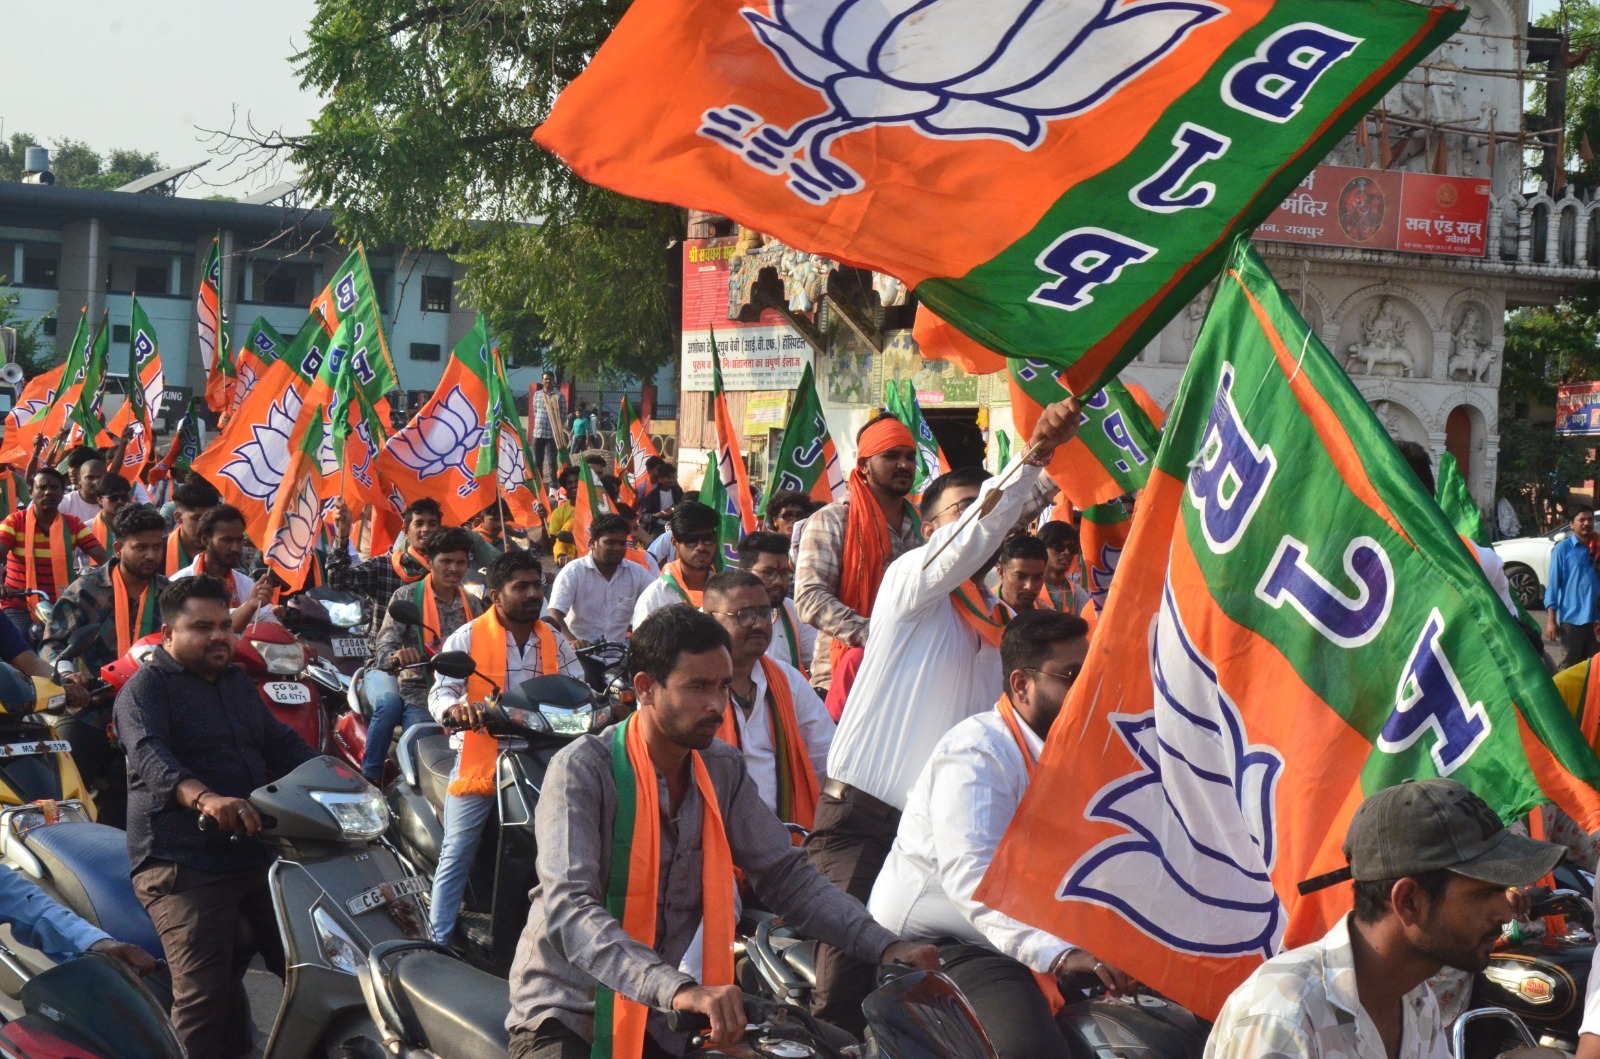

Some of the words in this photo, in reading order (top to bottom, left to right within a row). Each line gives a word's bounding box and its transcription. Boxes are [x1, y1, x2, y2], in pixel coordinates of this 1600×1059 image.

[1280, 193, 1328, 218] मंदिर
[1284, 225, 1324, 239] रायपुर
[1405, 217, 1431, 236] सन्
[1434, 215, 1453, 235] एंड
[688, 244, 698, 263] श्री
[730, 337, 740, 353] बेबी
[755, 358, 763, 368] का
[162, 390, 183, 401] KING
[272, 683, 287, 691] CG
